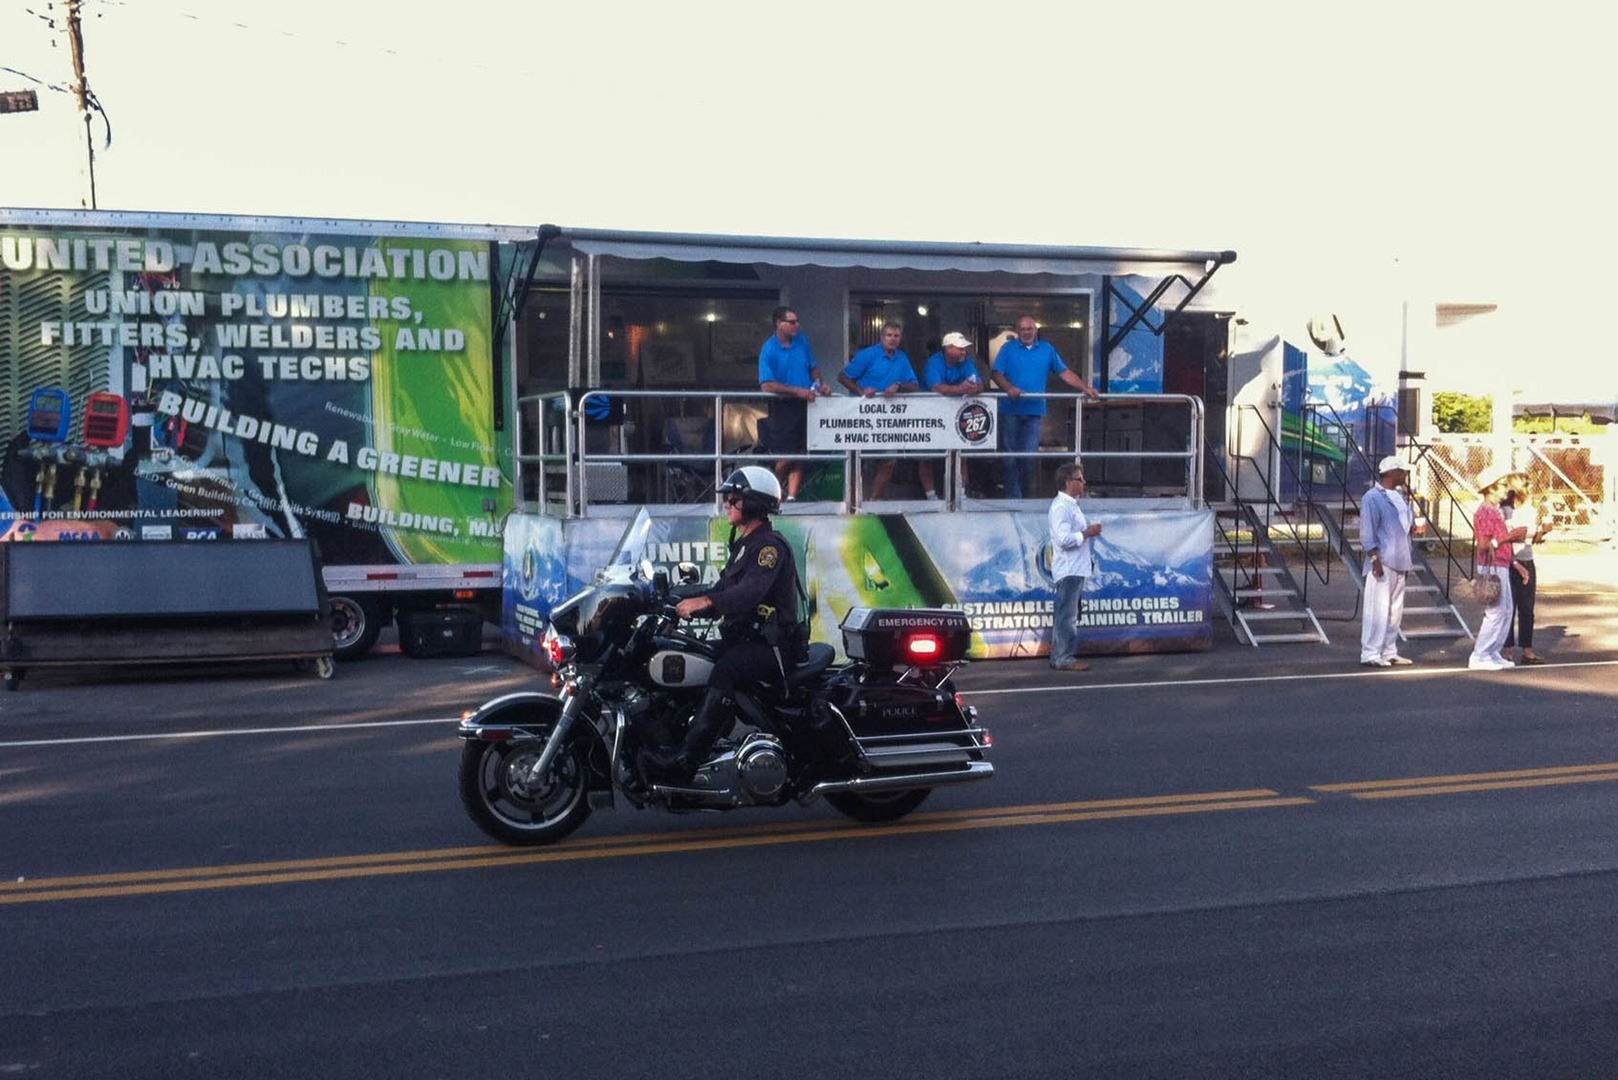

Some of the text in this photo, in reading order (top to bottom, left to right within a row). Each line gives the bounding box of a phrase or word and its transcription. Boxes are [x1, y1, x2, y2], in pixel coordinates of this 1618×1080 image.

[1, 237, 489, 281] UNITED ASSOCIATION
[85, 289, 422, 323] UNION PLUMBERS,
[41, 321, 465, 352] FITTERS, WELDERS AND
[150, 354, 370, 381] HVAC TECHS
[859, 403, 908, 414] LOCAL 267
[819, 418, 946, 430] PLUMBERS, STEAMFITTERS,
[965, 416, 987, 433] 267
[157, 390, 501, 488] BUILDING A GREENER
[834, 432, 931, 443] & HVAC TECHNICIANS
[0, 507, 225, 520] ERSHIP FOR ENVIRONMENTAL LEADERSHIP
[347, 502, 460, 536] BUILDING,
[646, 541, 729, 562] NITE
[1080, 596, 1180, 612] CHNOLOGIES
[878, 617, 945, 627] EMERGENCY
[1076, 611, 1137, 626] AINING
[1142, 610, 1203, 624] TRAILER
